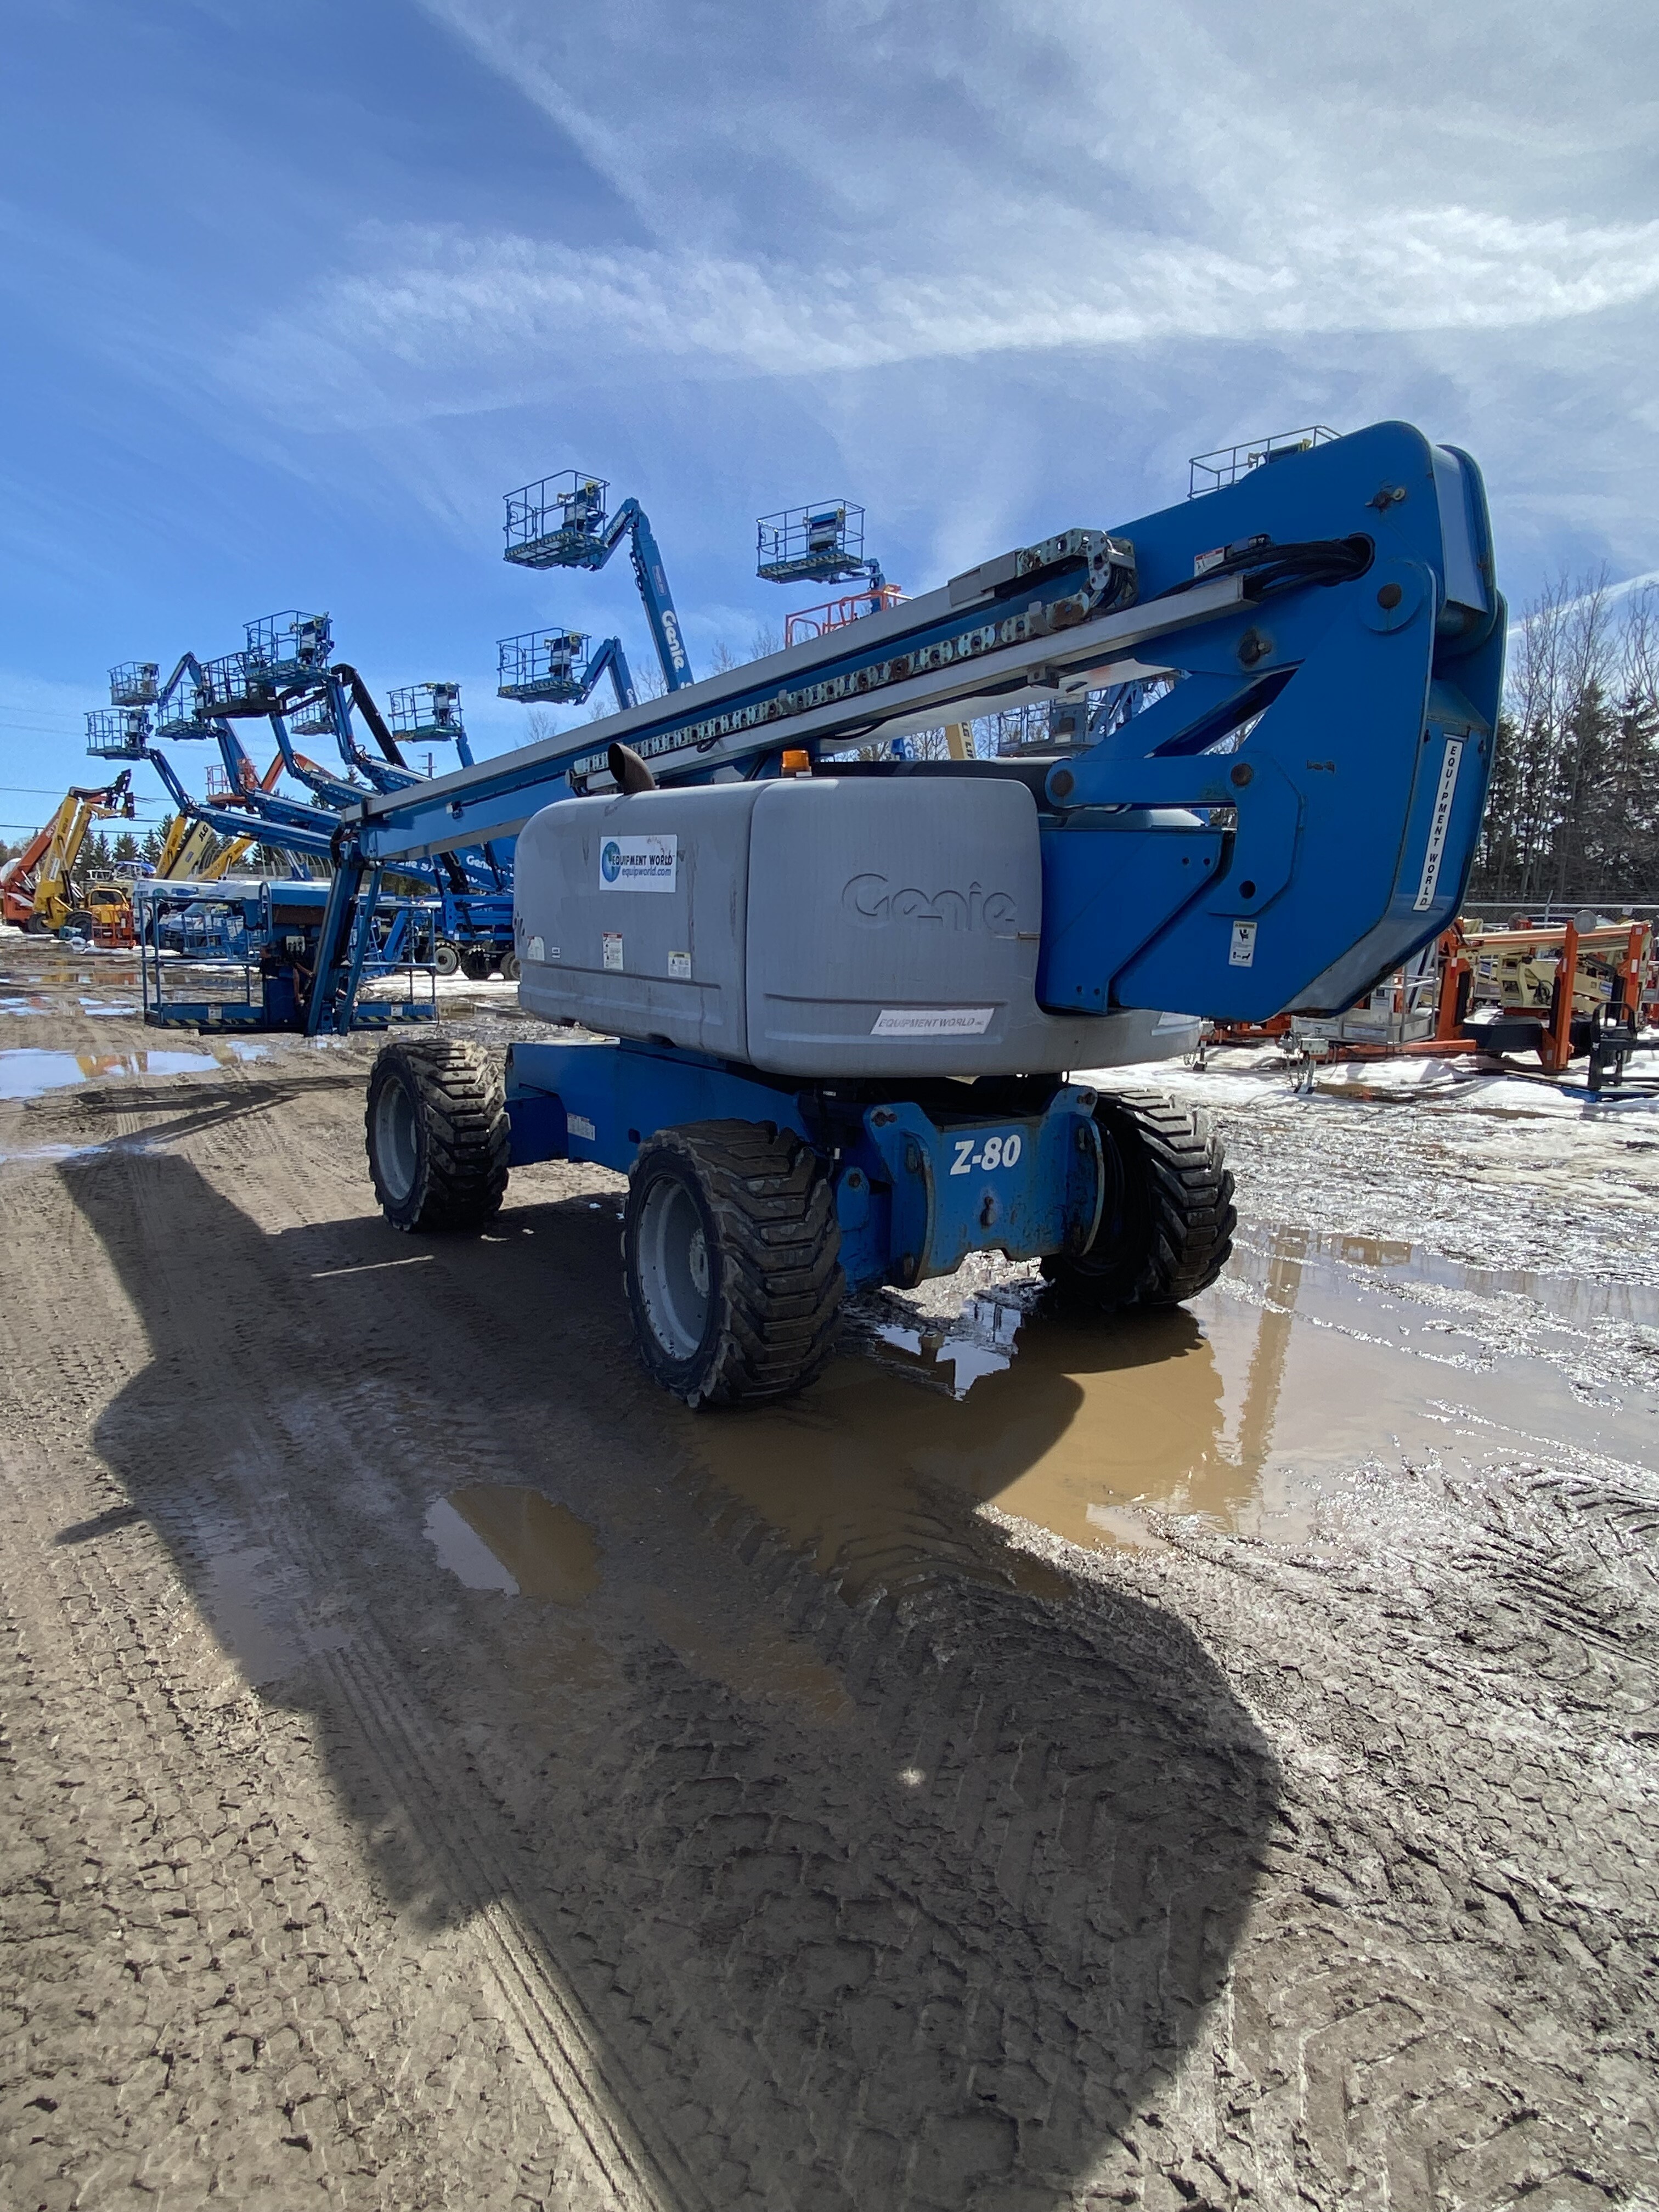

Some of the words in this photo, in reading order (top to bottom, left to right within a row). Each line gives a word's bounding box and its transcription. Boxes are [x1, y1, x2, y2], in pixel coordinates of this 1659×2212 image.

[662, 610, 685, 669] Genie
[1434, 746, 1457, 847] EQUIPMENT
[199, 825, 209, 843] JLG
[612, 855, 647, 866] EQUIPMENT
[649, 854, 673, 866] WORLD
[622, 866, 672, 879] equipworld.com
[1419, 853, 1438, 906] WORLD
[840, 872, 1017, 934] Genie
[878, 1018, 939, 1028] EQUIPMENT
[938, 1017, 975, 1027] WORLD
[950, 1134, 1022, 1176] Z-80
